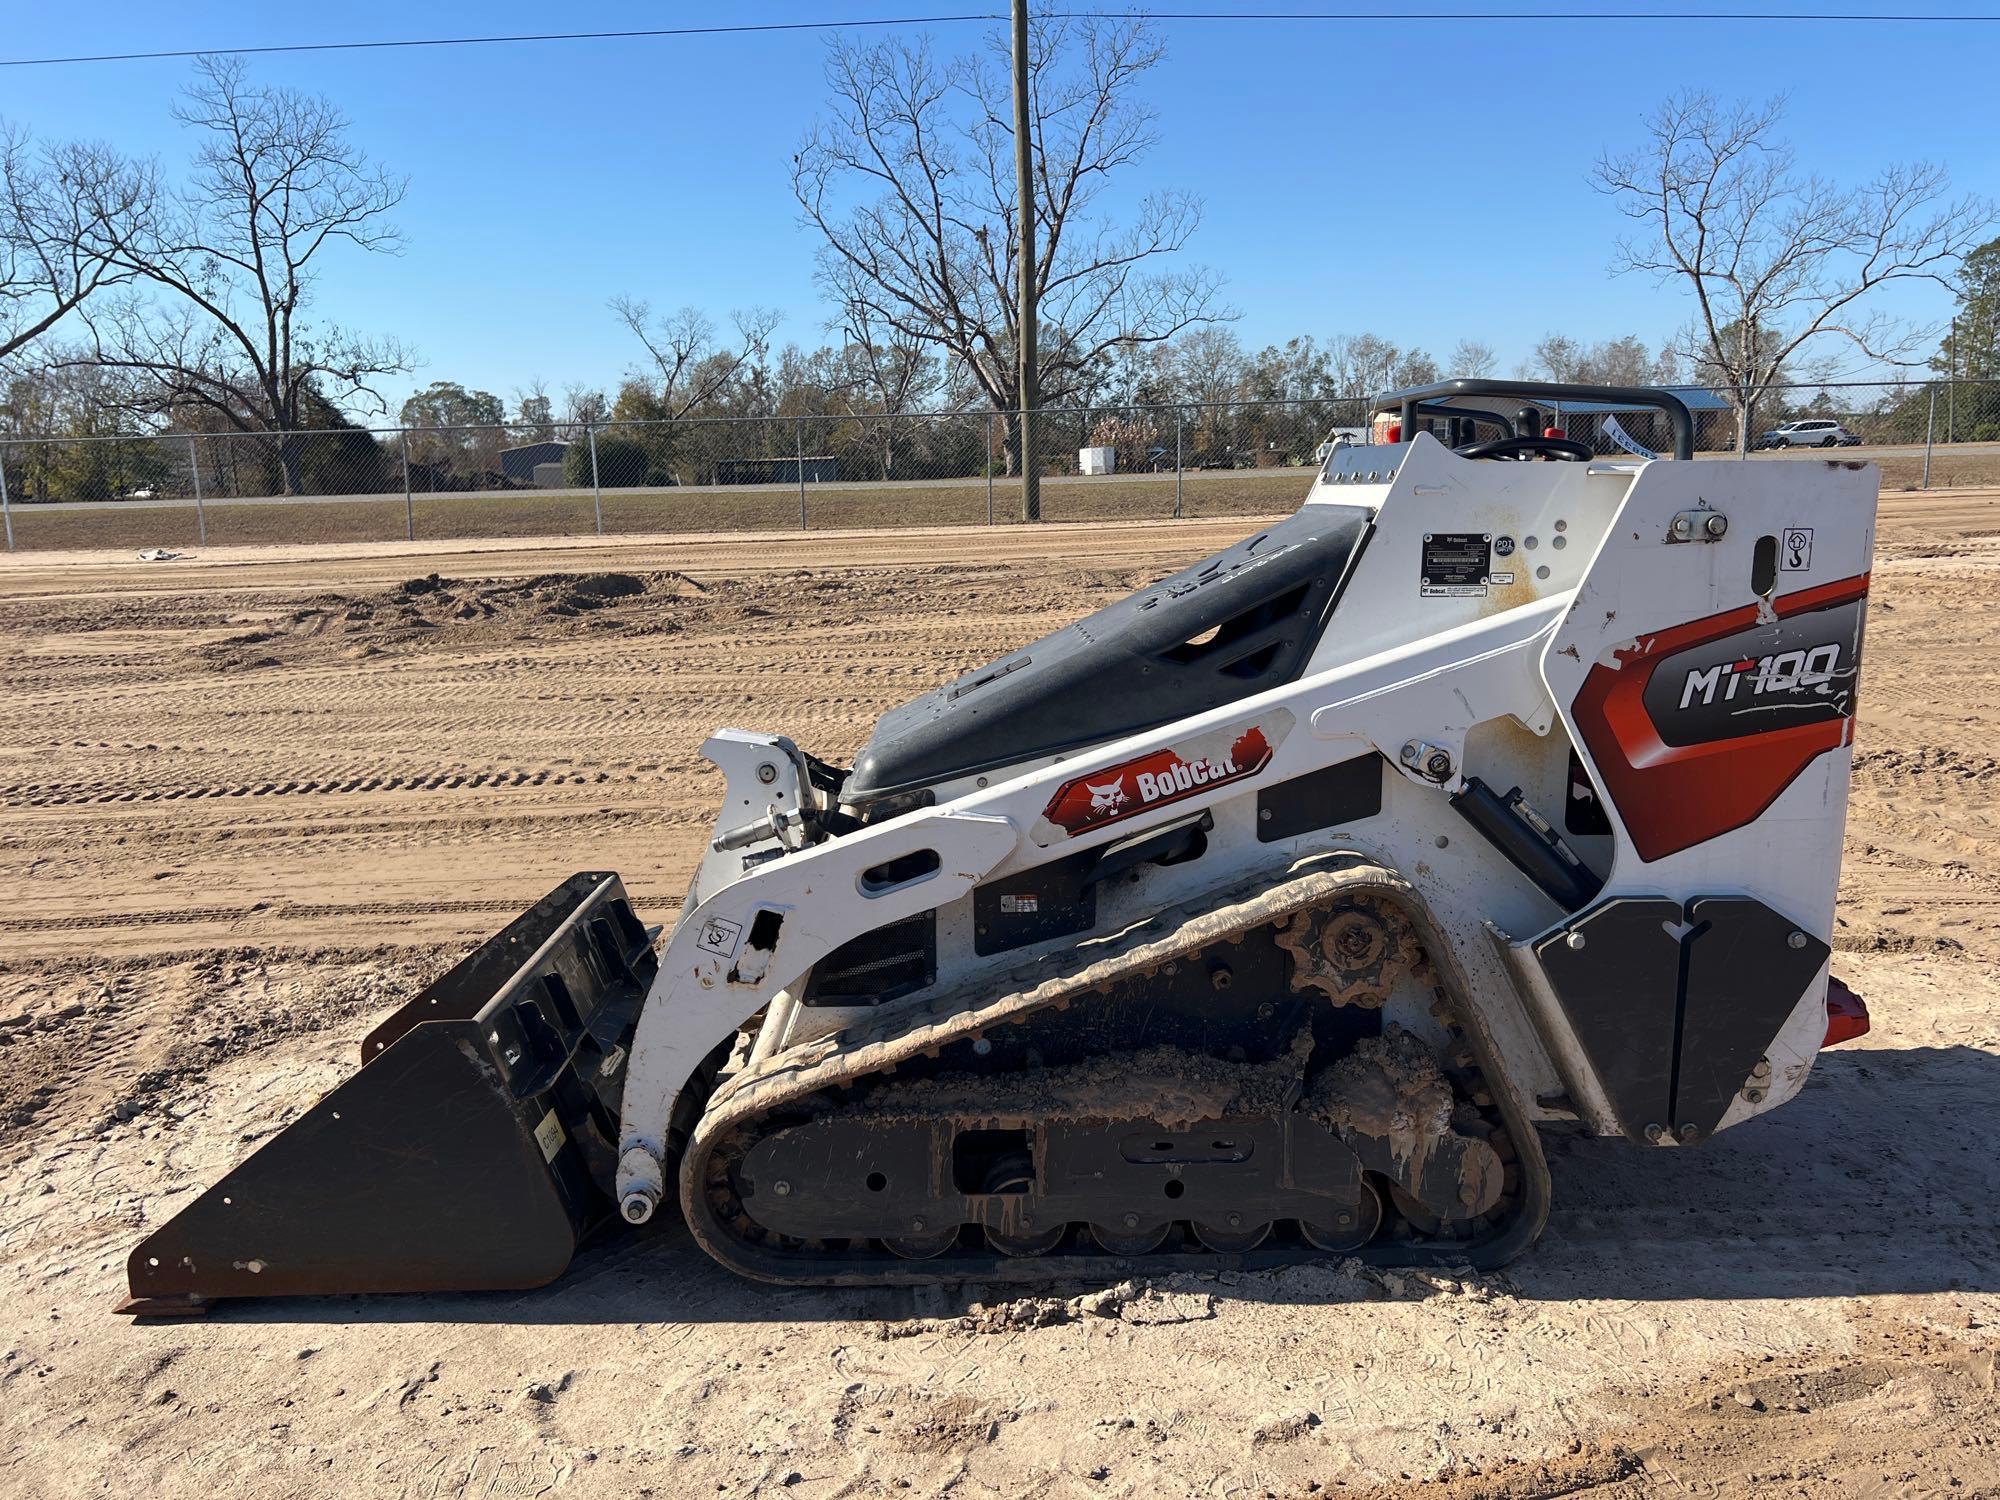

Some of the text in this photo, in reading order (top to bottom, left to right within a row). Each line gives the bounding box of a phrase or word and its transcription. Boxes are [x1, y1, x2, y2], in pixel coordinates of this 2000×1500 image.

[1496, 540, 1512, 548] PDI
[1679, 643, 1841, 709] MT100
[1136, 758, 1236, 803] Bobcat
